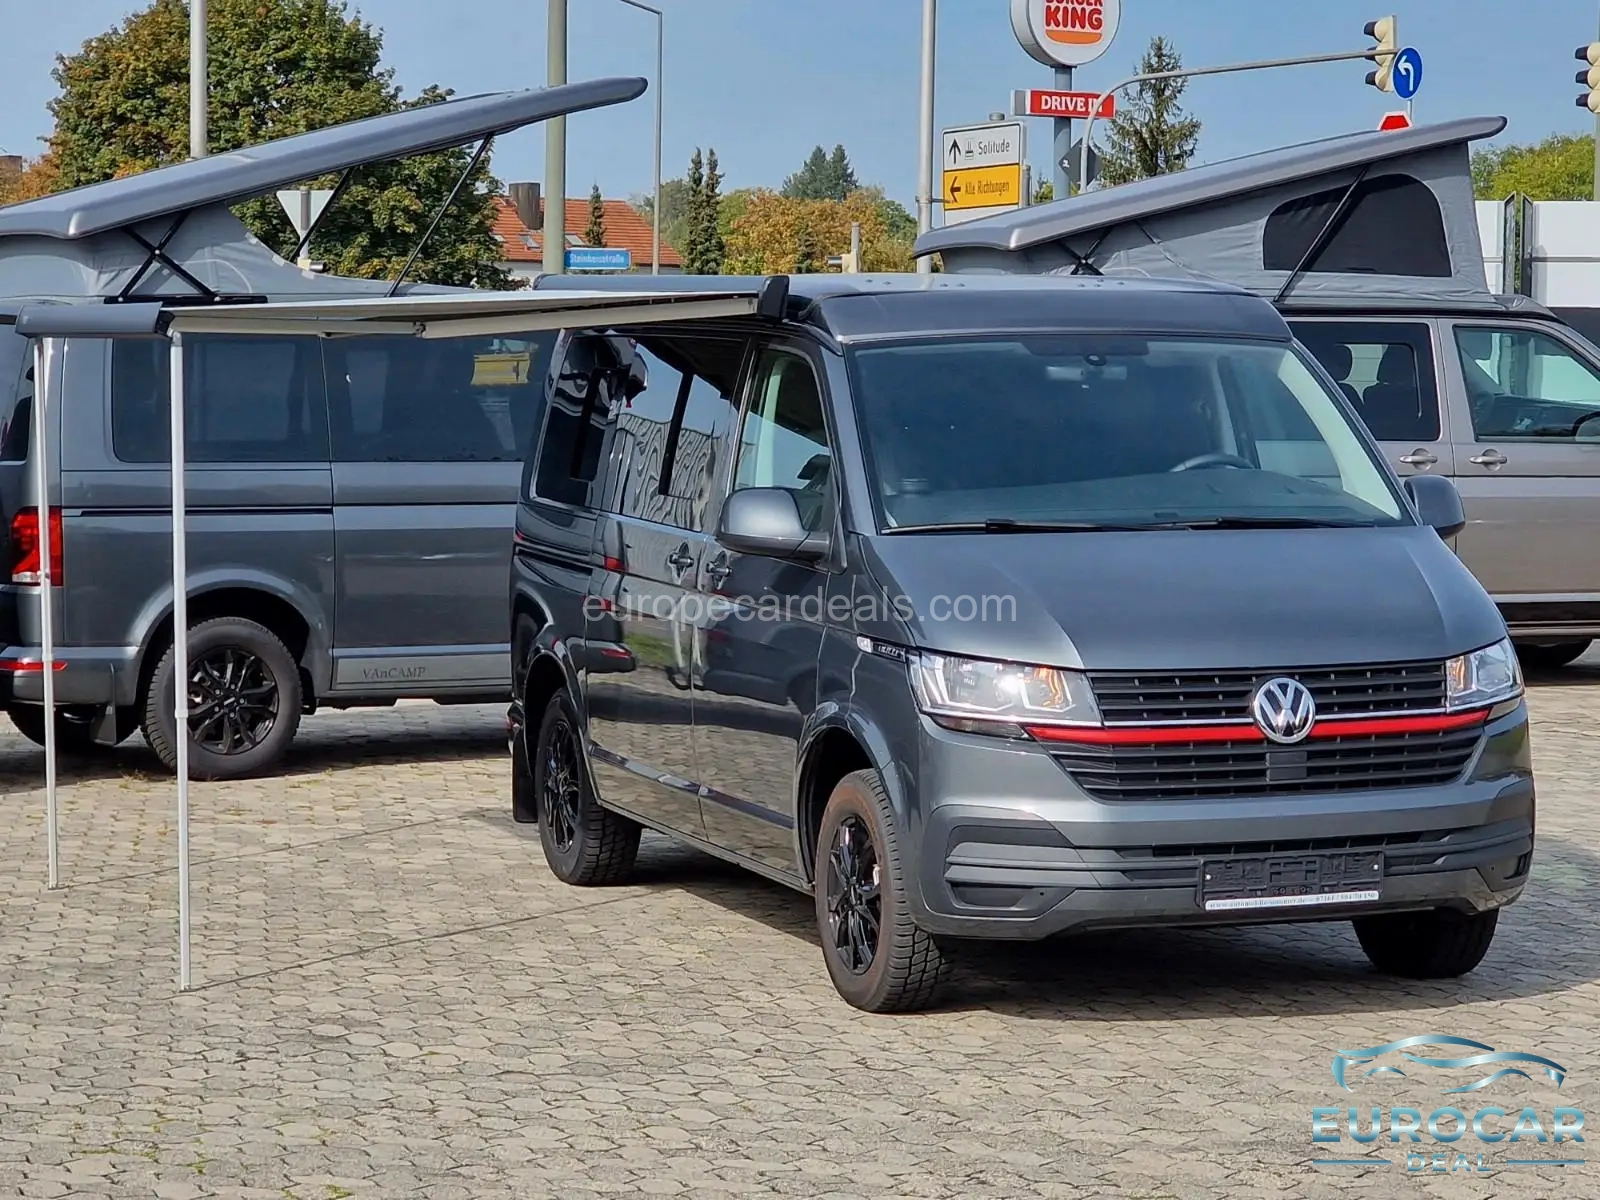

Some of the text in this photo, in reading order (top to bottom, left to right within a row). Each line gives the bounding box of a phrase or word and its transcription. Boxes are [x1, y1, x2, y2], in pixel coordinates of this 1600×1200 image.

[1045, 5, 1103, 30] KING
[1041, 95, 1086, 112] DRIVE
[978, 139, 1010, 156] Solitude
[977, 180, 1010, 197] Richtungen
